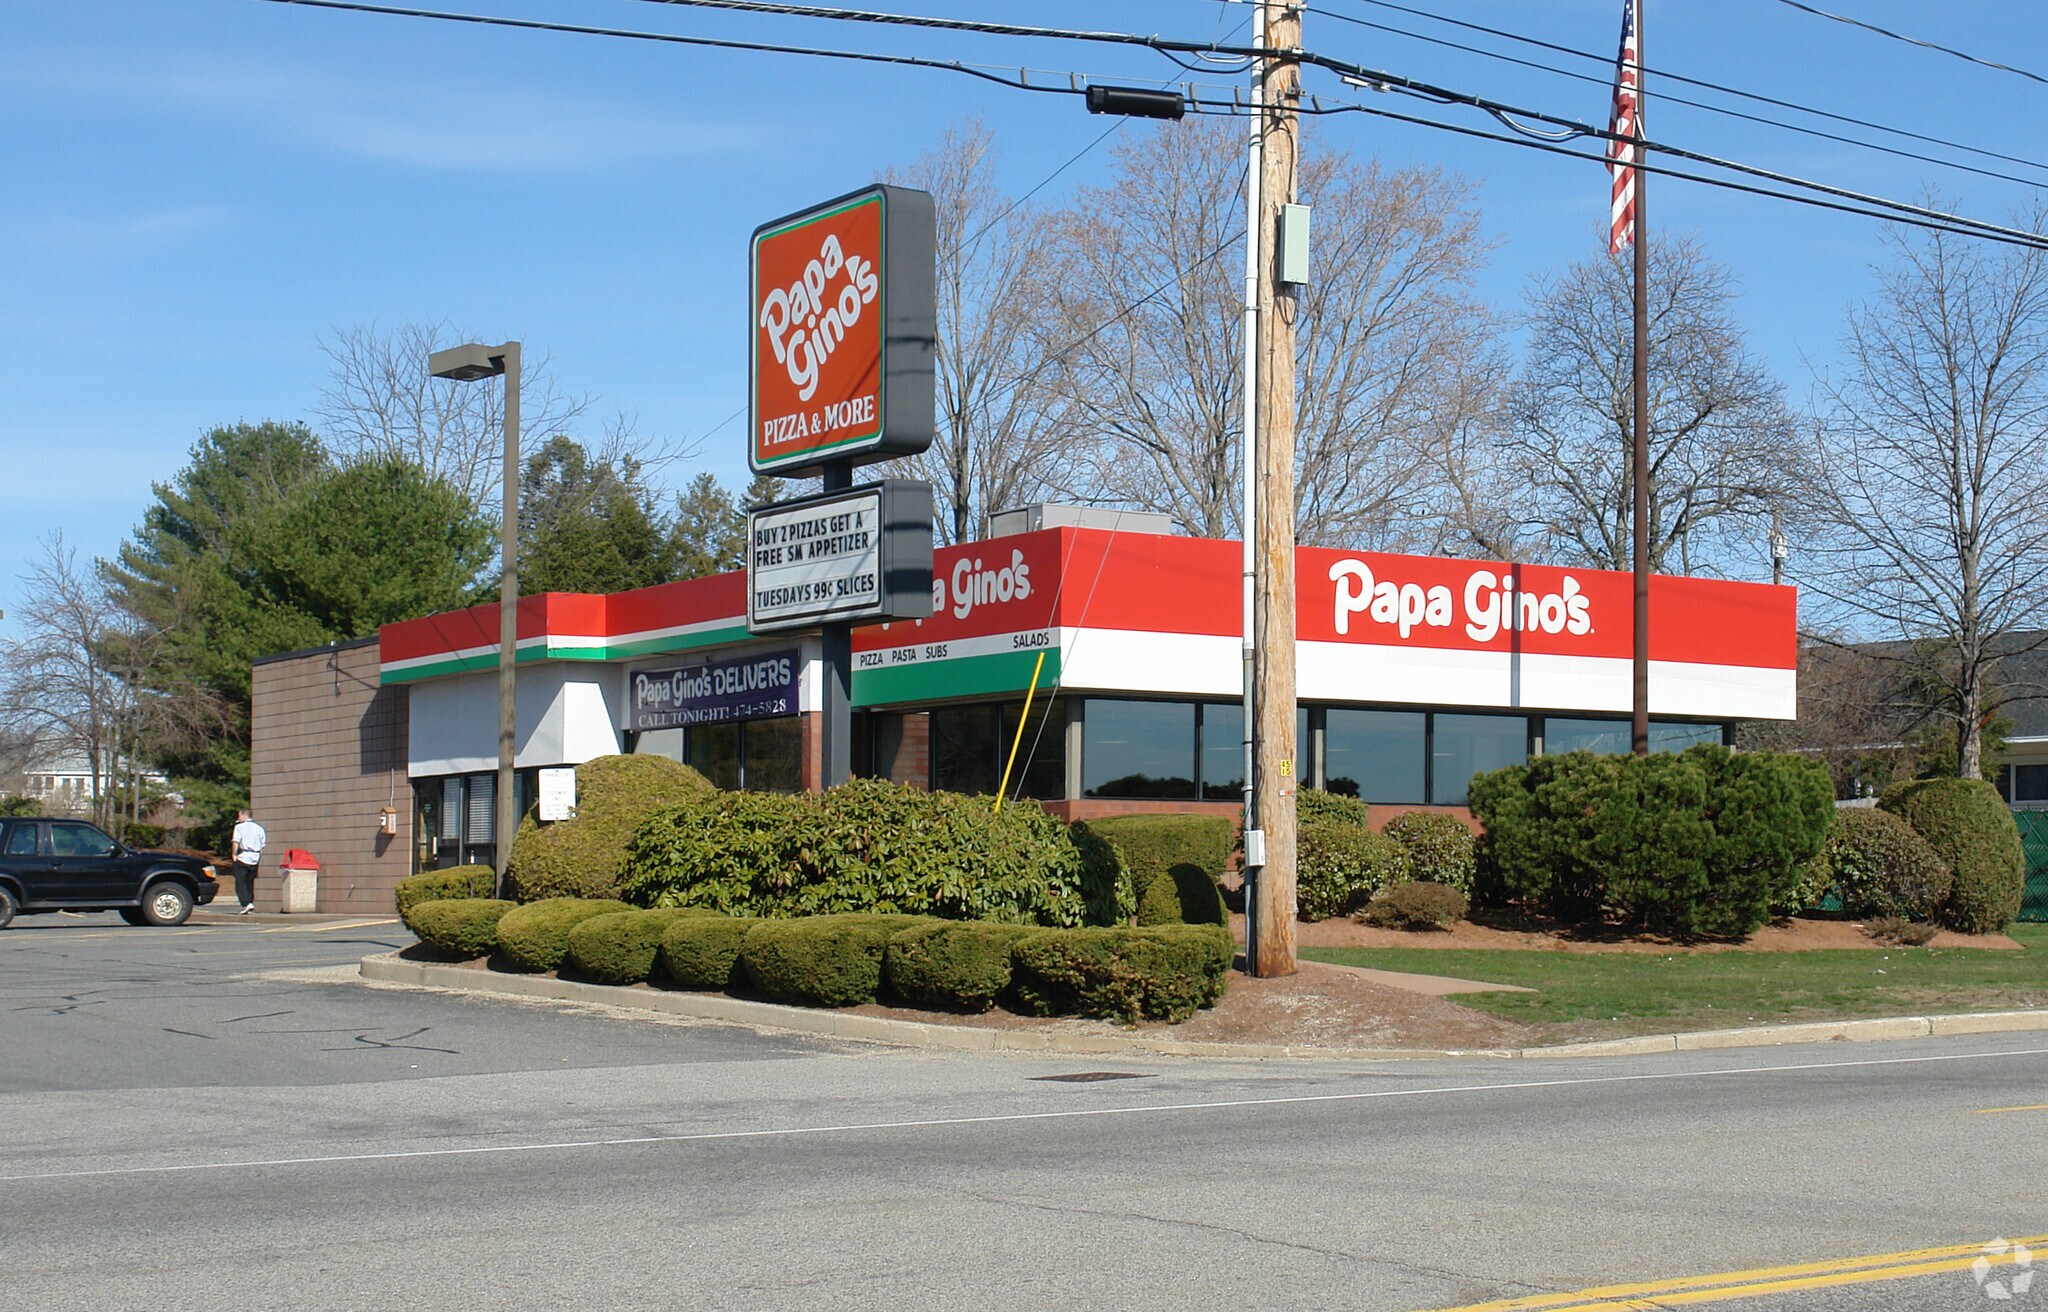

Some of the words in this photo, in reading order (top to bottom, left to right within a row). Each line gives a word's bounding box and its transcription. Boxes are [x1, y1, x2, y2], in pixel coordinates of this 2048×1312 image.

[760, 234, 844, 364] Papa
[786, 255, 878, 402] Gino's
[764, 412, 808, 446] PIZZA
[811, 412, 822, 435] &
[824, 394, 875, 431] MORE
[756, 526, 777, 547] BUY
[781, 526, 787, 542] 2
[789, 520, 827, 541] PIZZAS
[830, 513, 851, 533] GET
[855, 511, 863, 529] A
[756, 548, 783, 567] FREE
[788, 543, 804, 562] SM
[808, 531, 868, 559] APPETIZER
[757, 584, 811, 609] TUESDAYS
[814, 581, 833, 600] 99¢
[836, 573, 874, 596] SLICES
[951, 549, 1031, 620] Gino's
[1328, 558, 1453, 640] Papa
[1464, 570, 1591, 643] Gino's
[860, 652, 884, 667] PIZZA
[892, 648, 917, 663] PASTA
[925, 644, 948, 659] SUBS
[1013, 632, 1050, 649] SALADS
[635, 673, 670, 709] Papa
[672, 667, 712, 707] Gino's
[713, 658, 791, 695] DELIVERS
[638, 712, 669, 728] CALL
[671, 707, 730, 725] TONIGHT!
[733, 698, 787, 717] 474-5828
